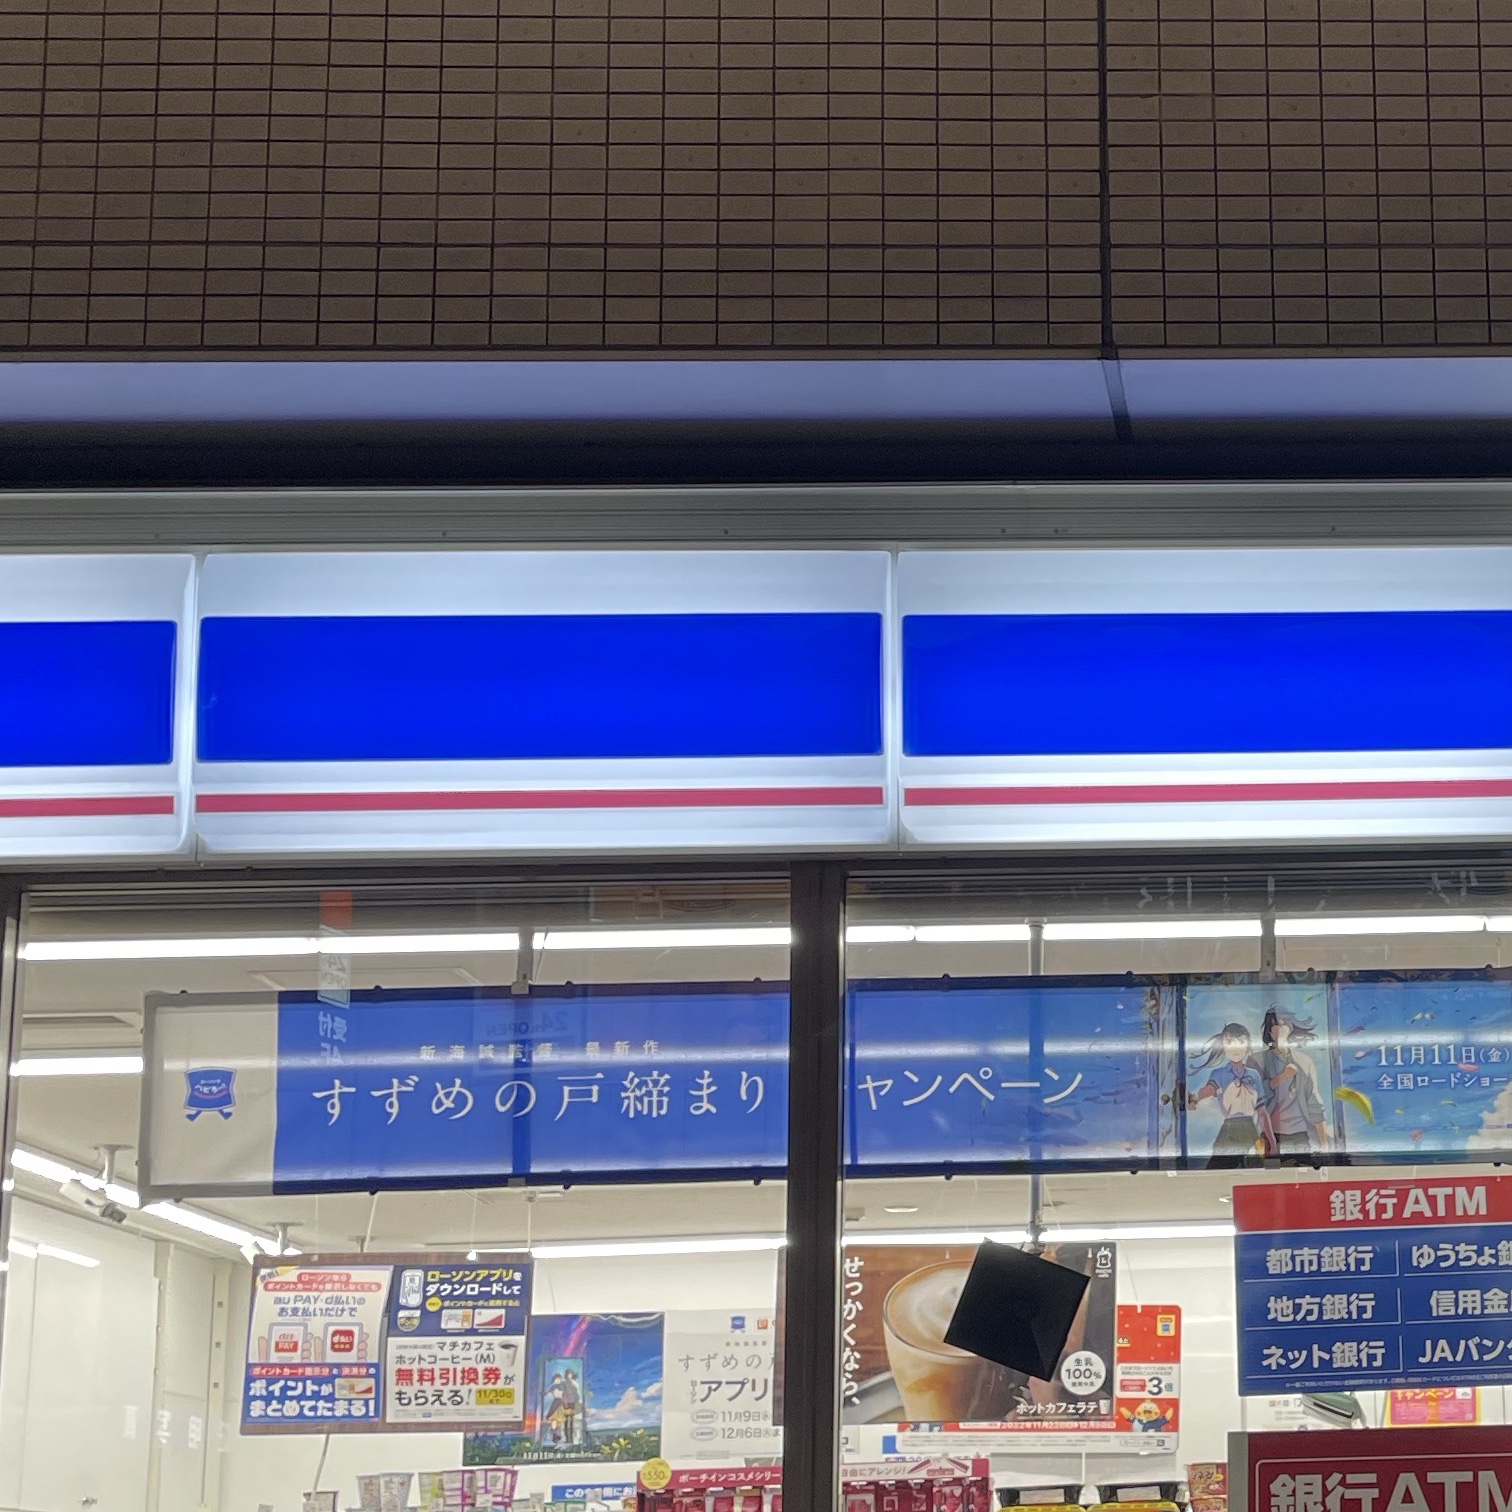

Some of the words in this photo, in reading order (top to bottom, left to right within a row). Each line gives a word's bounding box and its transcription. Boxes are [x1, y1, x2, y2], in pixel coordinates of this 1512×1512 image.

[1376, 1072, 1508, 1090] 全国ロードショー
[312, 1069, 764, 1126] すずめの戸締まり
[843, 1067, 1084, 1110] ャンペーン
[1329, 1184, 1488, 1221] 銀行ATM
[1265, 1244, 1374, 1275] 都市銀行
[425, 1283, 521, 1297] ダウンロードして
[1267, 1292, 1377, 1322] 地方銀行
[436, 1341, 495, 1351] マチカフェ
[1261, 1340, 1386, 1370] ネット銀行
[394, 1366, 516, 1387] 無料引換券が
[1065, 1368, 1102, 1380] 100%
[248, 1377, 333, 1397] ポイントが
[700, 1377, 769, 1403] アプリ
[394, 1388, 472, 1407] もらえる!
[248, 1399, 376, 1418] まとめてたまる!
[1016, 1400, 1099, 1416] ホットカフェラテ
